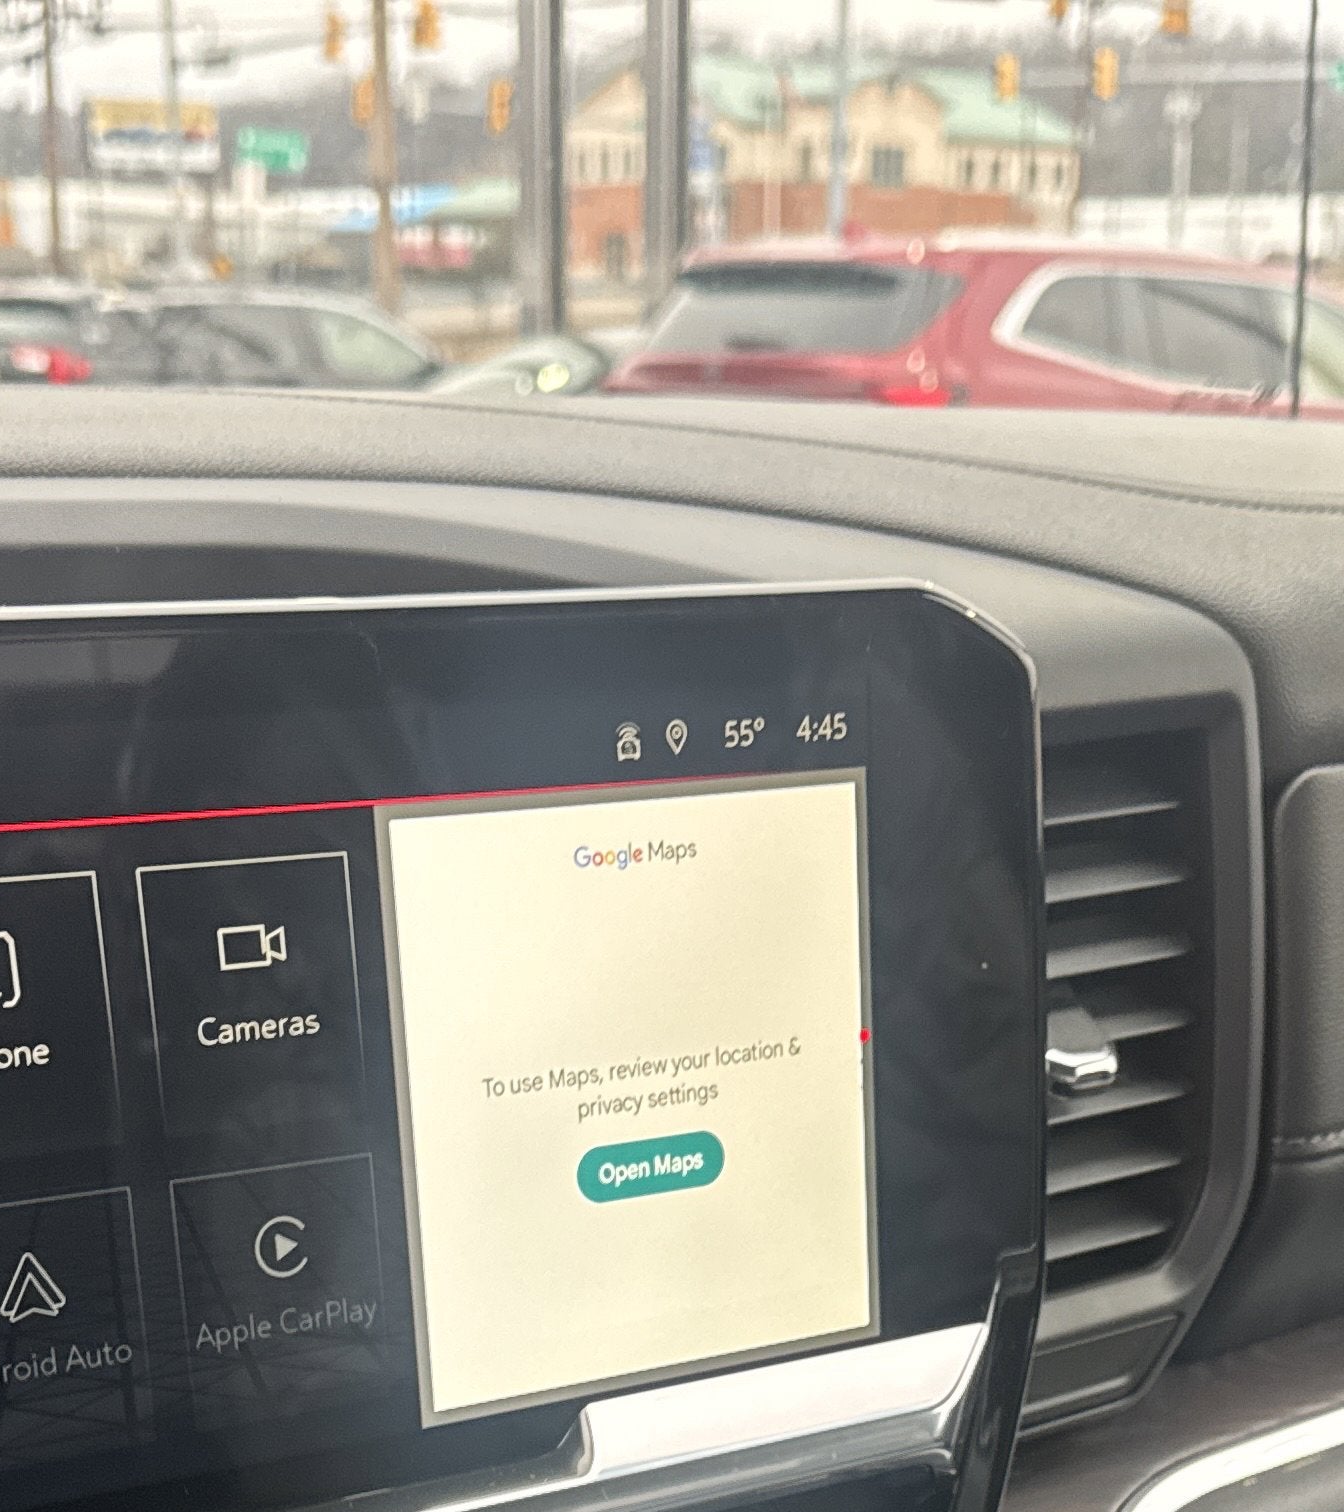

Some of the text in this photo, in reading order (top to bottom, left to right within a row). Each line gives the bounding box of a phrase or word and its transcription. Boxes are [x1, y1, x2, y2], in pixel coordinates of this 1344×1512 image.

[795, 711, 848, 744] 4:45
[573, 840, 698, 870] Google Maps
[196, 1011, 321, 1047] Cameras
[482, 1036, 802, 1099] To use Maps, review your location &
[577, 1081, 720, 1124] privacy settings
[598, 1151, 705, 1188] Open Maps
[195, 1297, 378, 1353] Apple CarPlay
[65, 1341, 134, 1373] Auto
